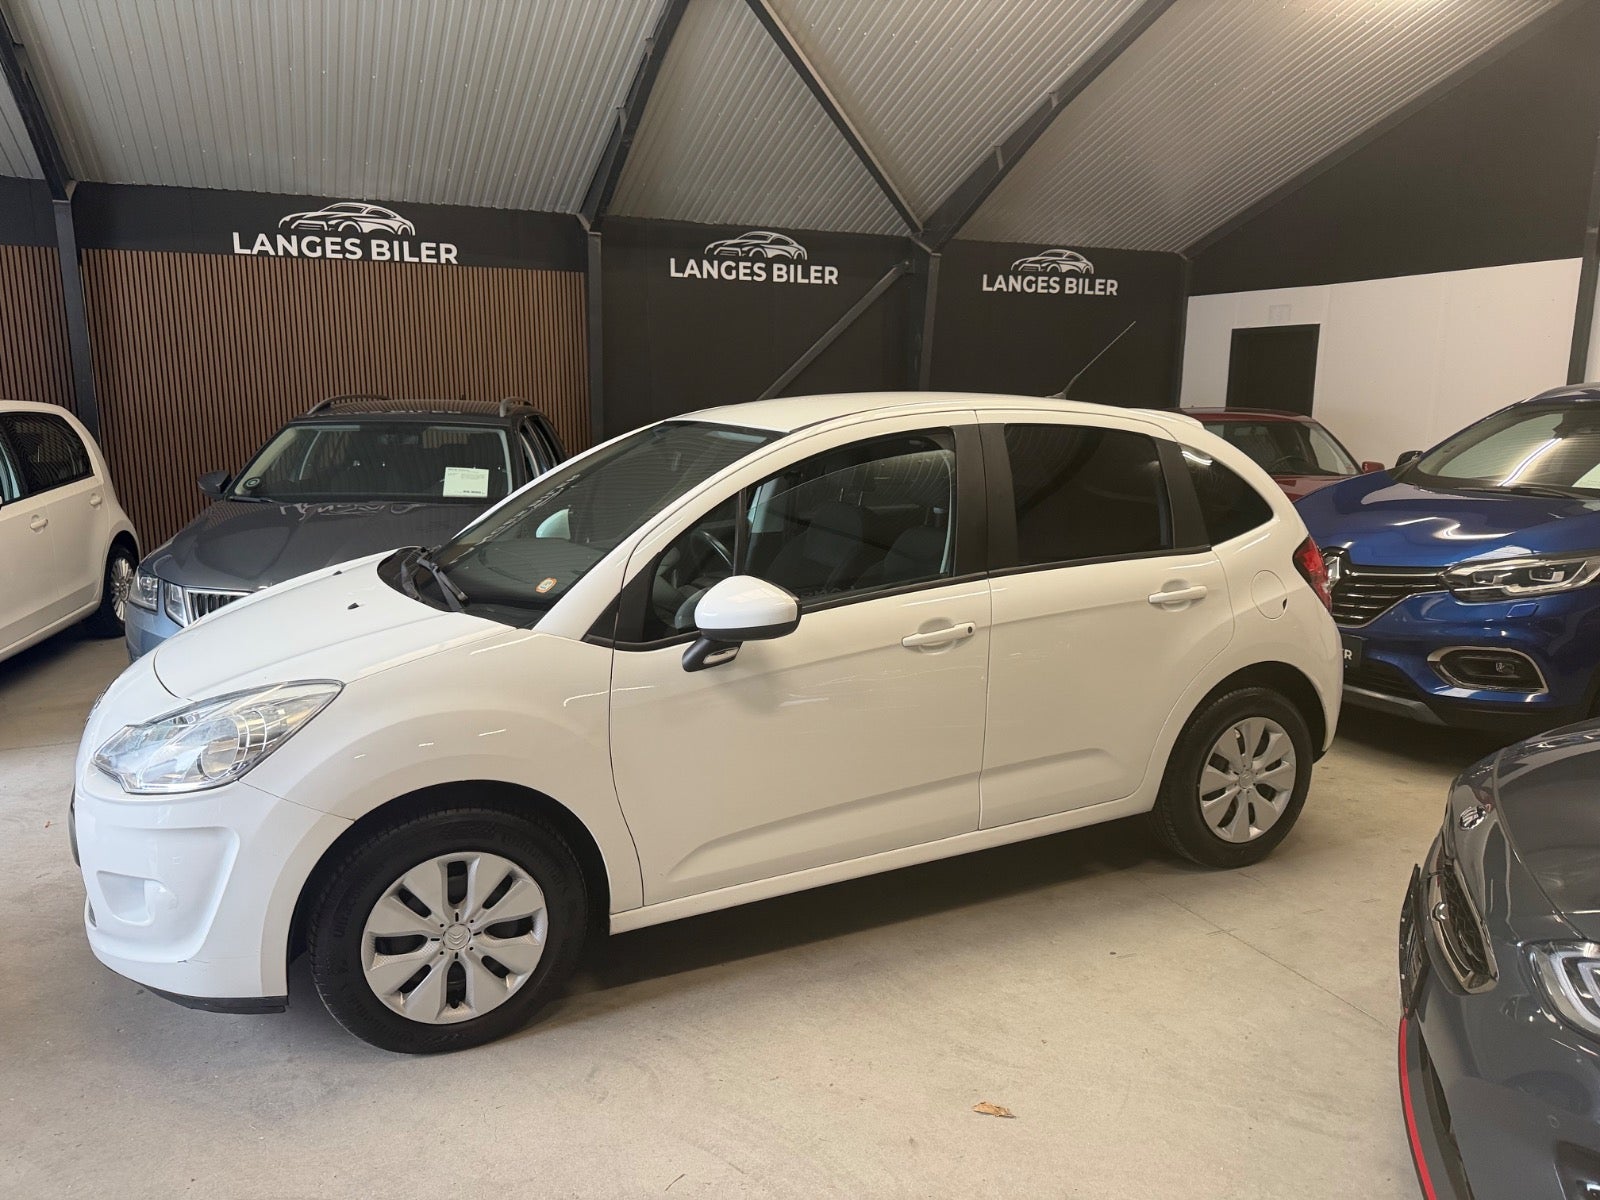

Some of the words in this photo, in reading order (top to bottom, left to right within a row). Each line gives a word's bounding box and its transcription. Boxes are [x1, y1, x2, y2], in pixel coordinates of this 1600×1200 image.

[232, 231, 363, 260] LANGES
[370, 239, 459, 265] BILER
[669, 257, 767, 282] LANGES
[772, 263, 839, 285] BILER
[981, 274, 1061, 294] LANGES
[1064, 277, 1119, 296] BILER
